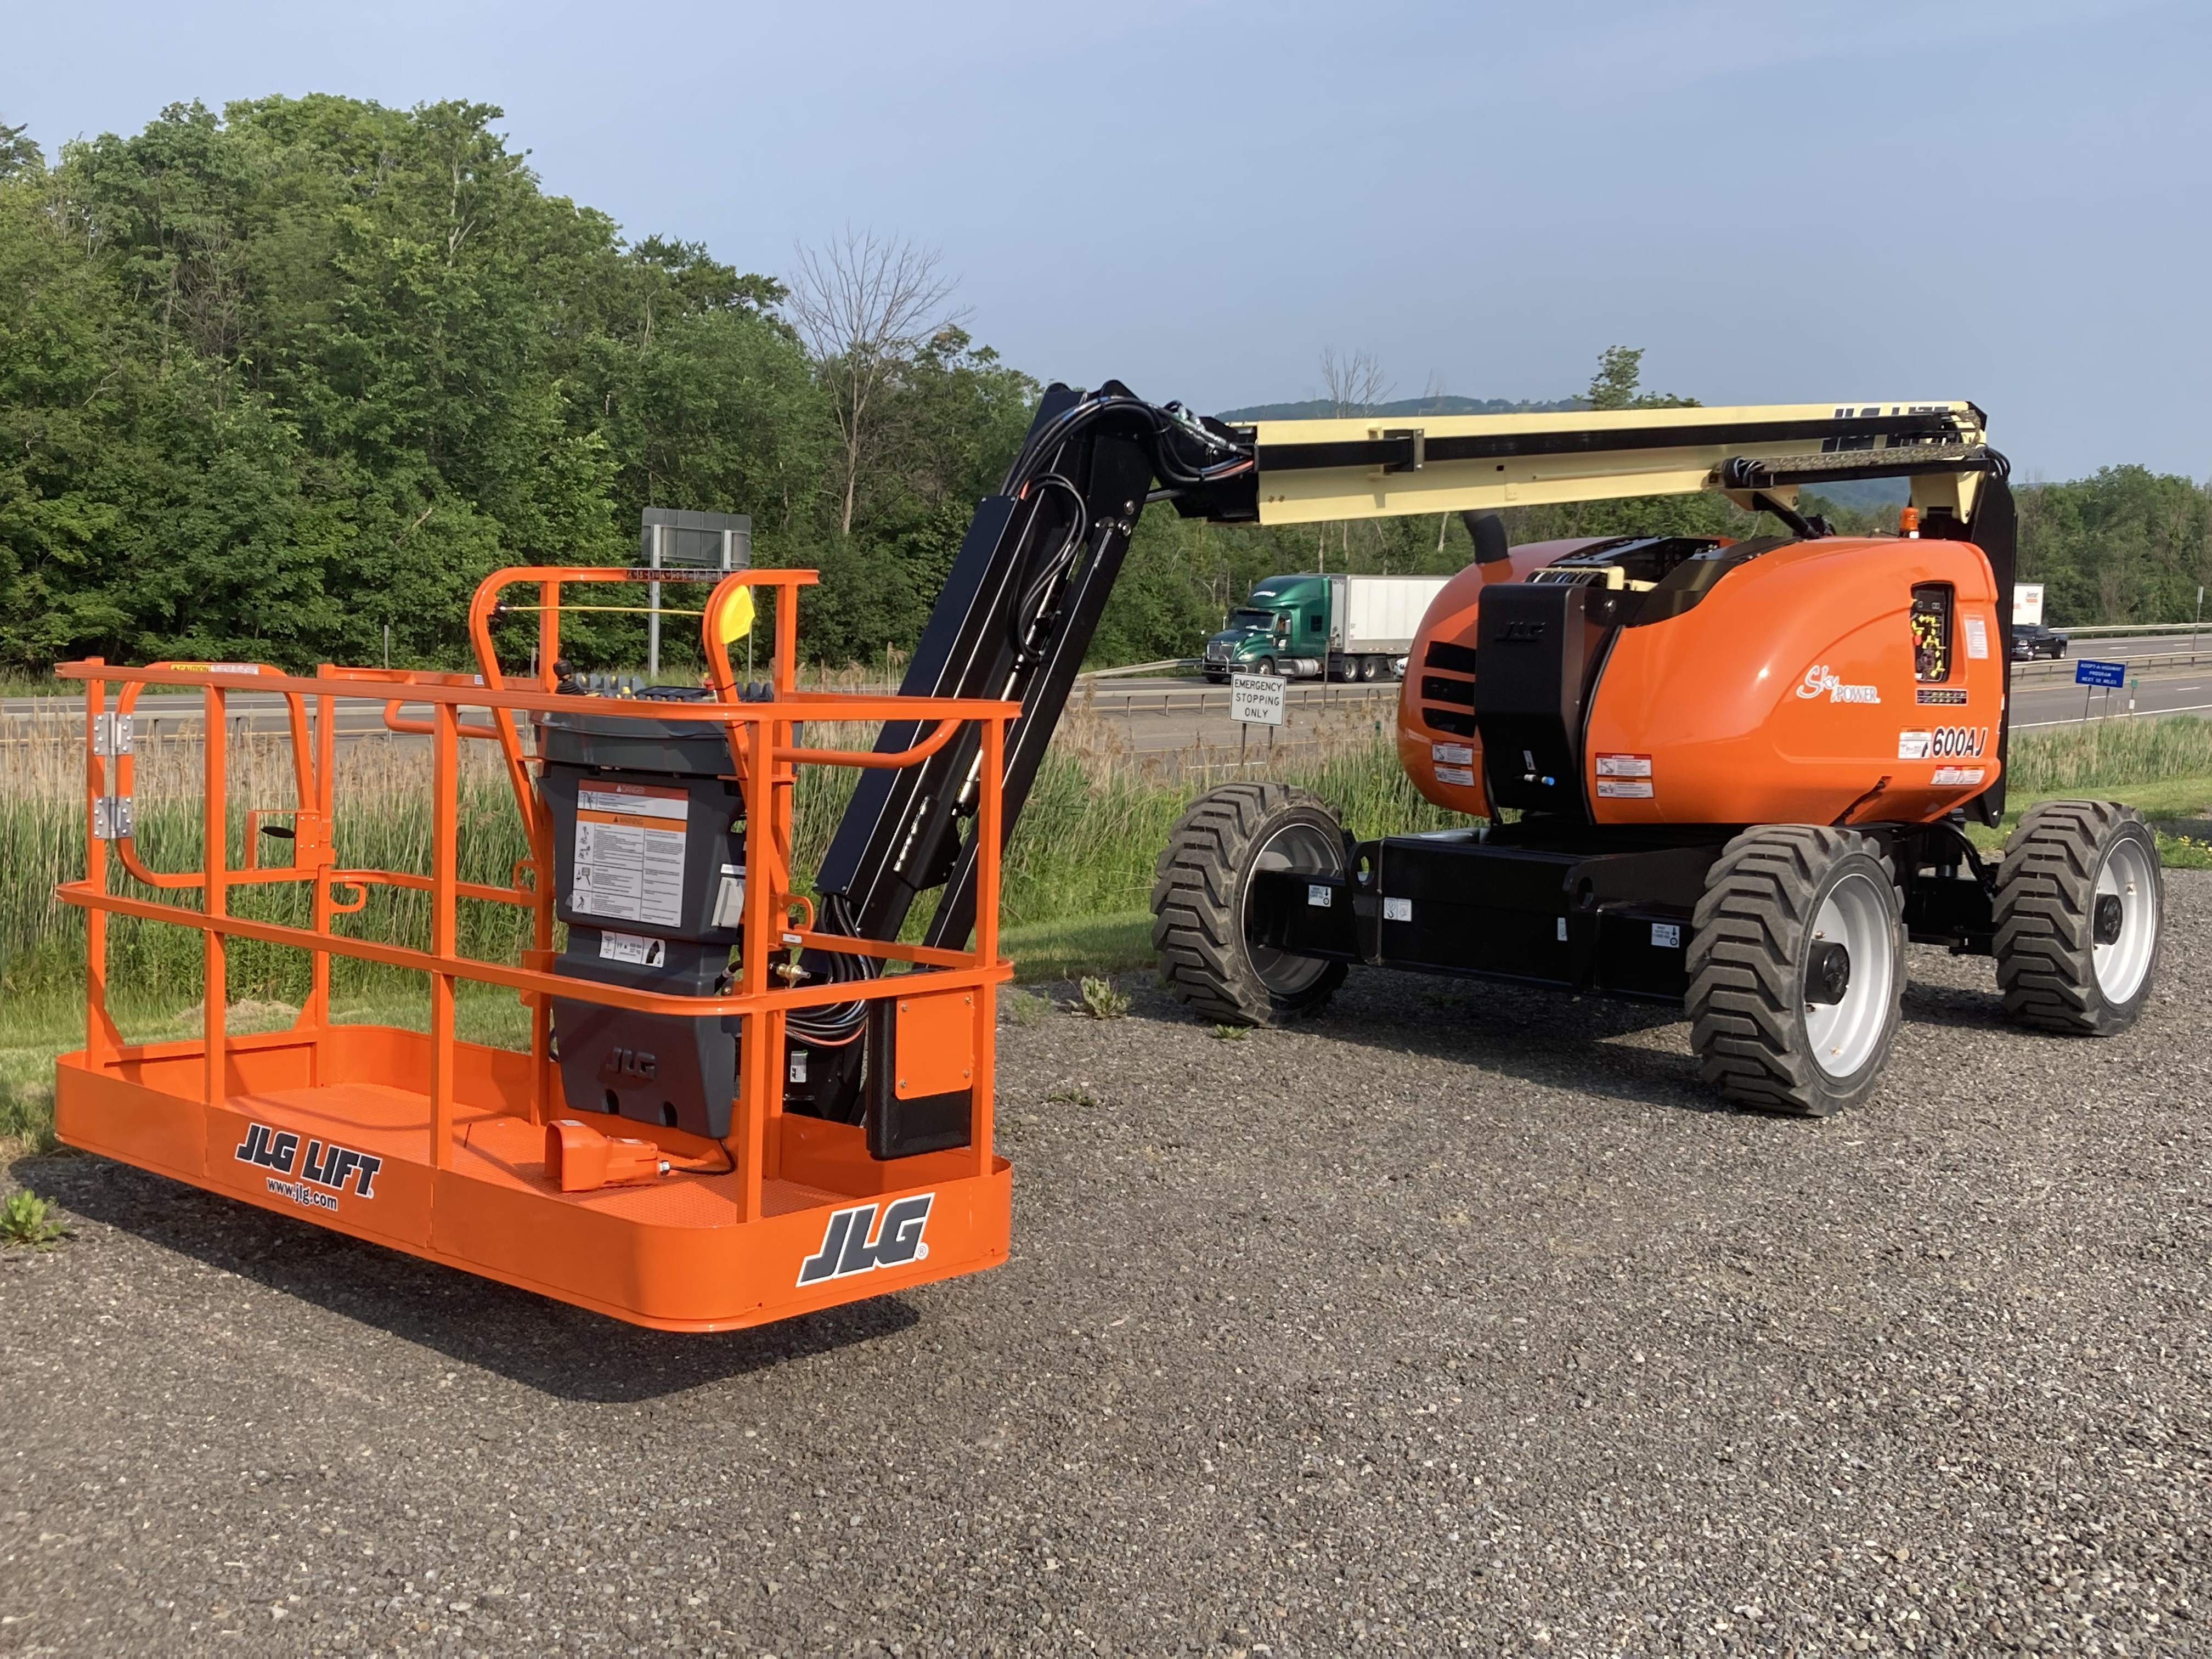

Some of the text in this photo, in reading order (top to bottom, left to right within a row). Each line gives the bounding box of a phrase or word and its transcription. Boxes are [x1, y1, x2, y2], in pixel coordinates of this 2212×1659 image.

[1234, 679, 1282, 692] EMERGENCY
[1836, 685, 1877, 703] POWER
[1235, 693, 1279, 706] STOPPING
[1245, 708, 1268, 718] ONLY
[1932, 727, 1988, 758] 600AJ
[622, 785, 645, 794] DANGER
[235, 1122, 383, 1196] JLG LIFT
[267, 1177, 338, 1211] www.jlg.com
[795, 1192, 935, 1287] JLG
